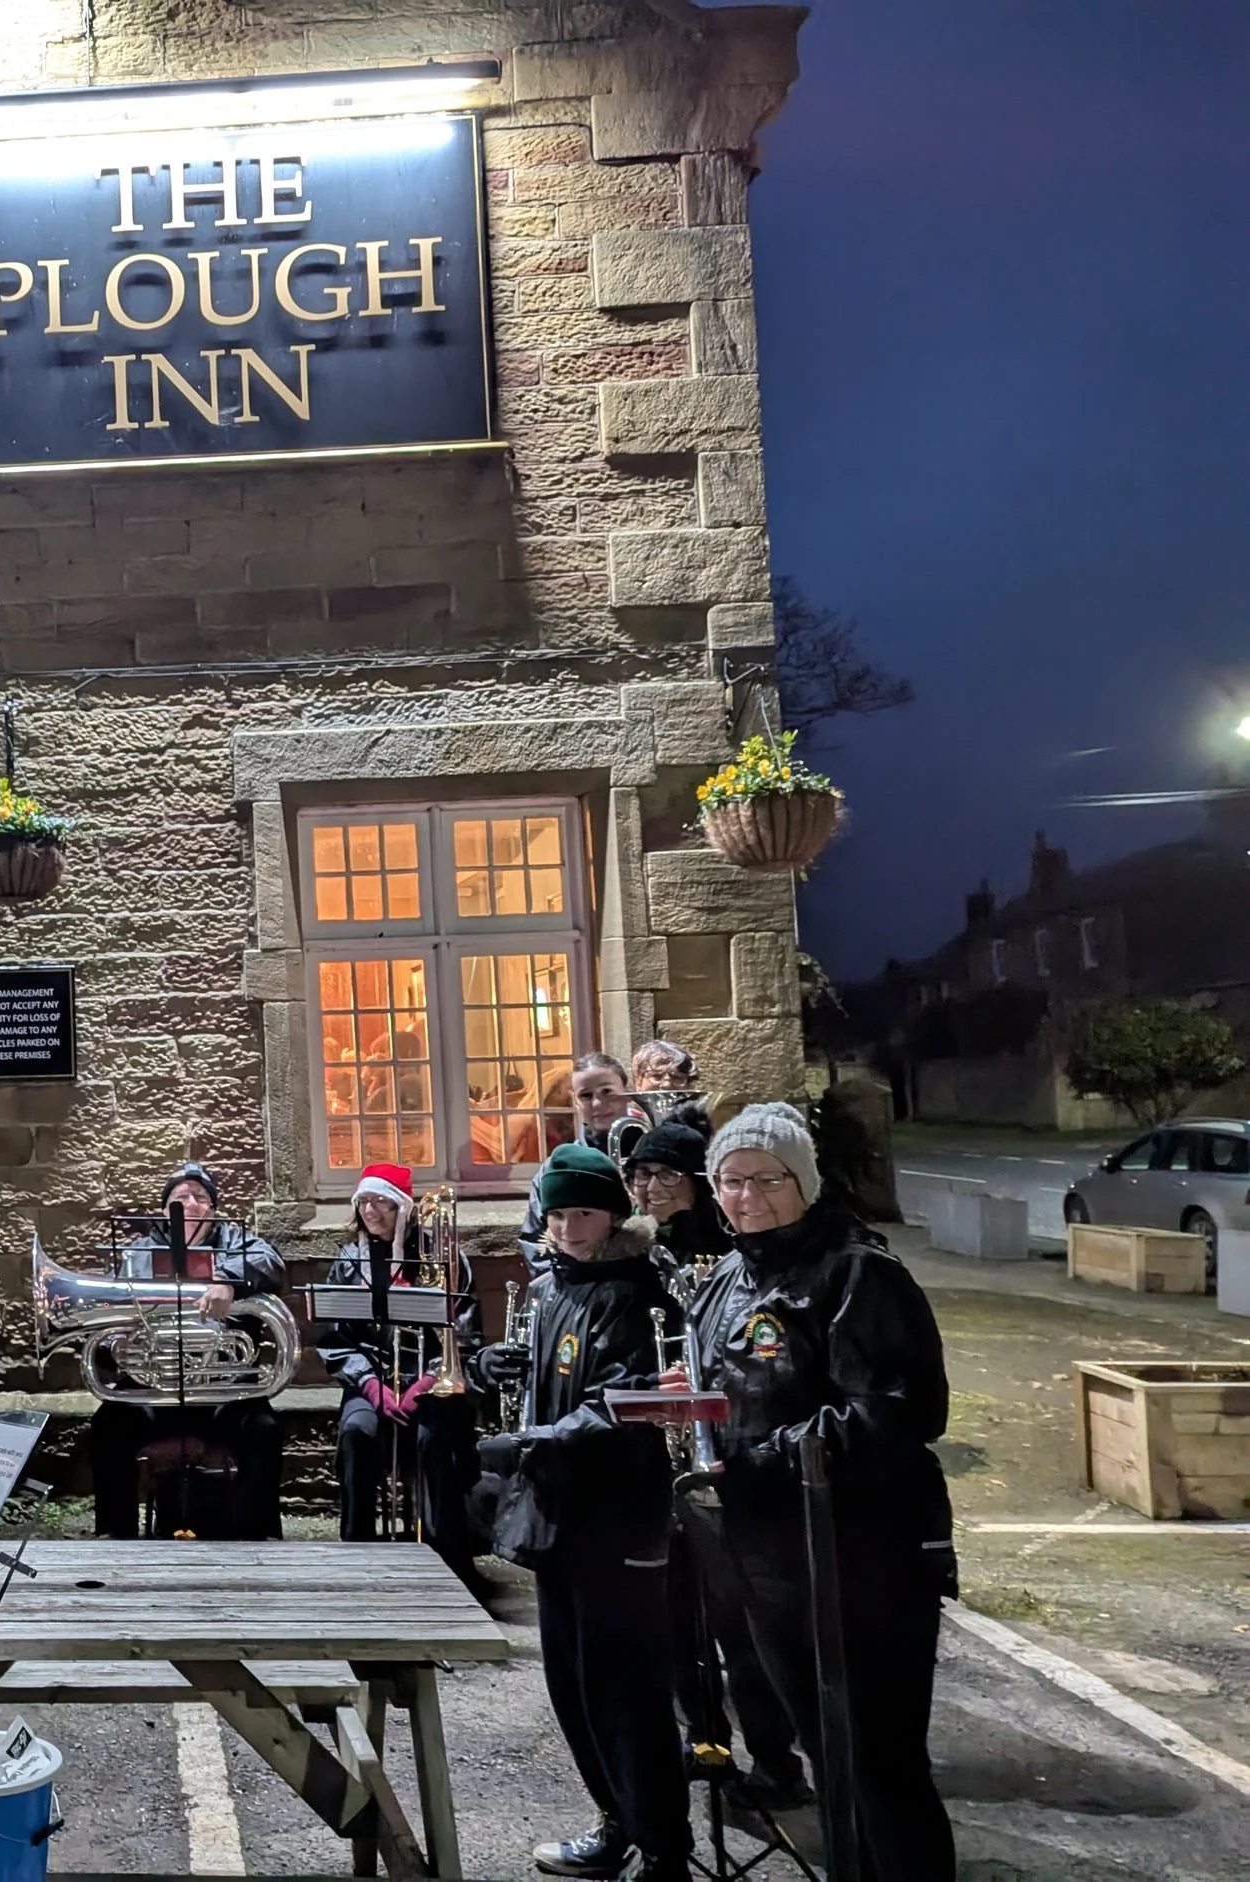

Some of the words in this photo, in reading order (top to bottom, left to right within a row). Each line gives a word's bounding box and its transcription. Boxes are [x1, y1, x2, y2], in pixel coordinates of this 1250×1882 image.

[95, 155, 312, 233] THE
[101, 344, 317, 431] INN
[11, 1001, 41, 1010] ACCEPT
[42, 1000, 59, 1009] ANY
[12, 1013, 28, 1022] FOR
[29, 1013, 49, 1022] LOSS
[49, 1013, 61, 1021] OF
[28, 1026, 39, 1034] TO
[41, 1025, 58, 1034] ANY
[16, 1038, 46, 1047] PARKED
[47, 1038, 60, 1046] ON
[14, 1050, 51, 1060] PREMISES
